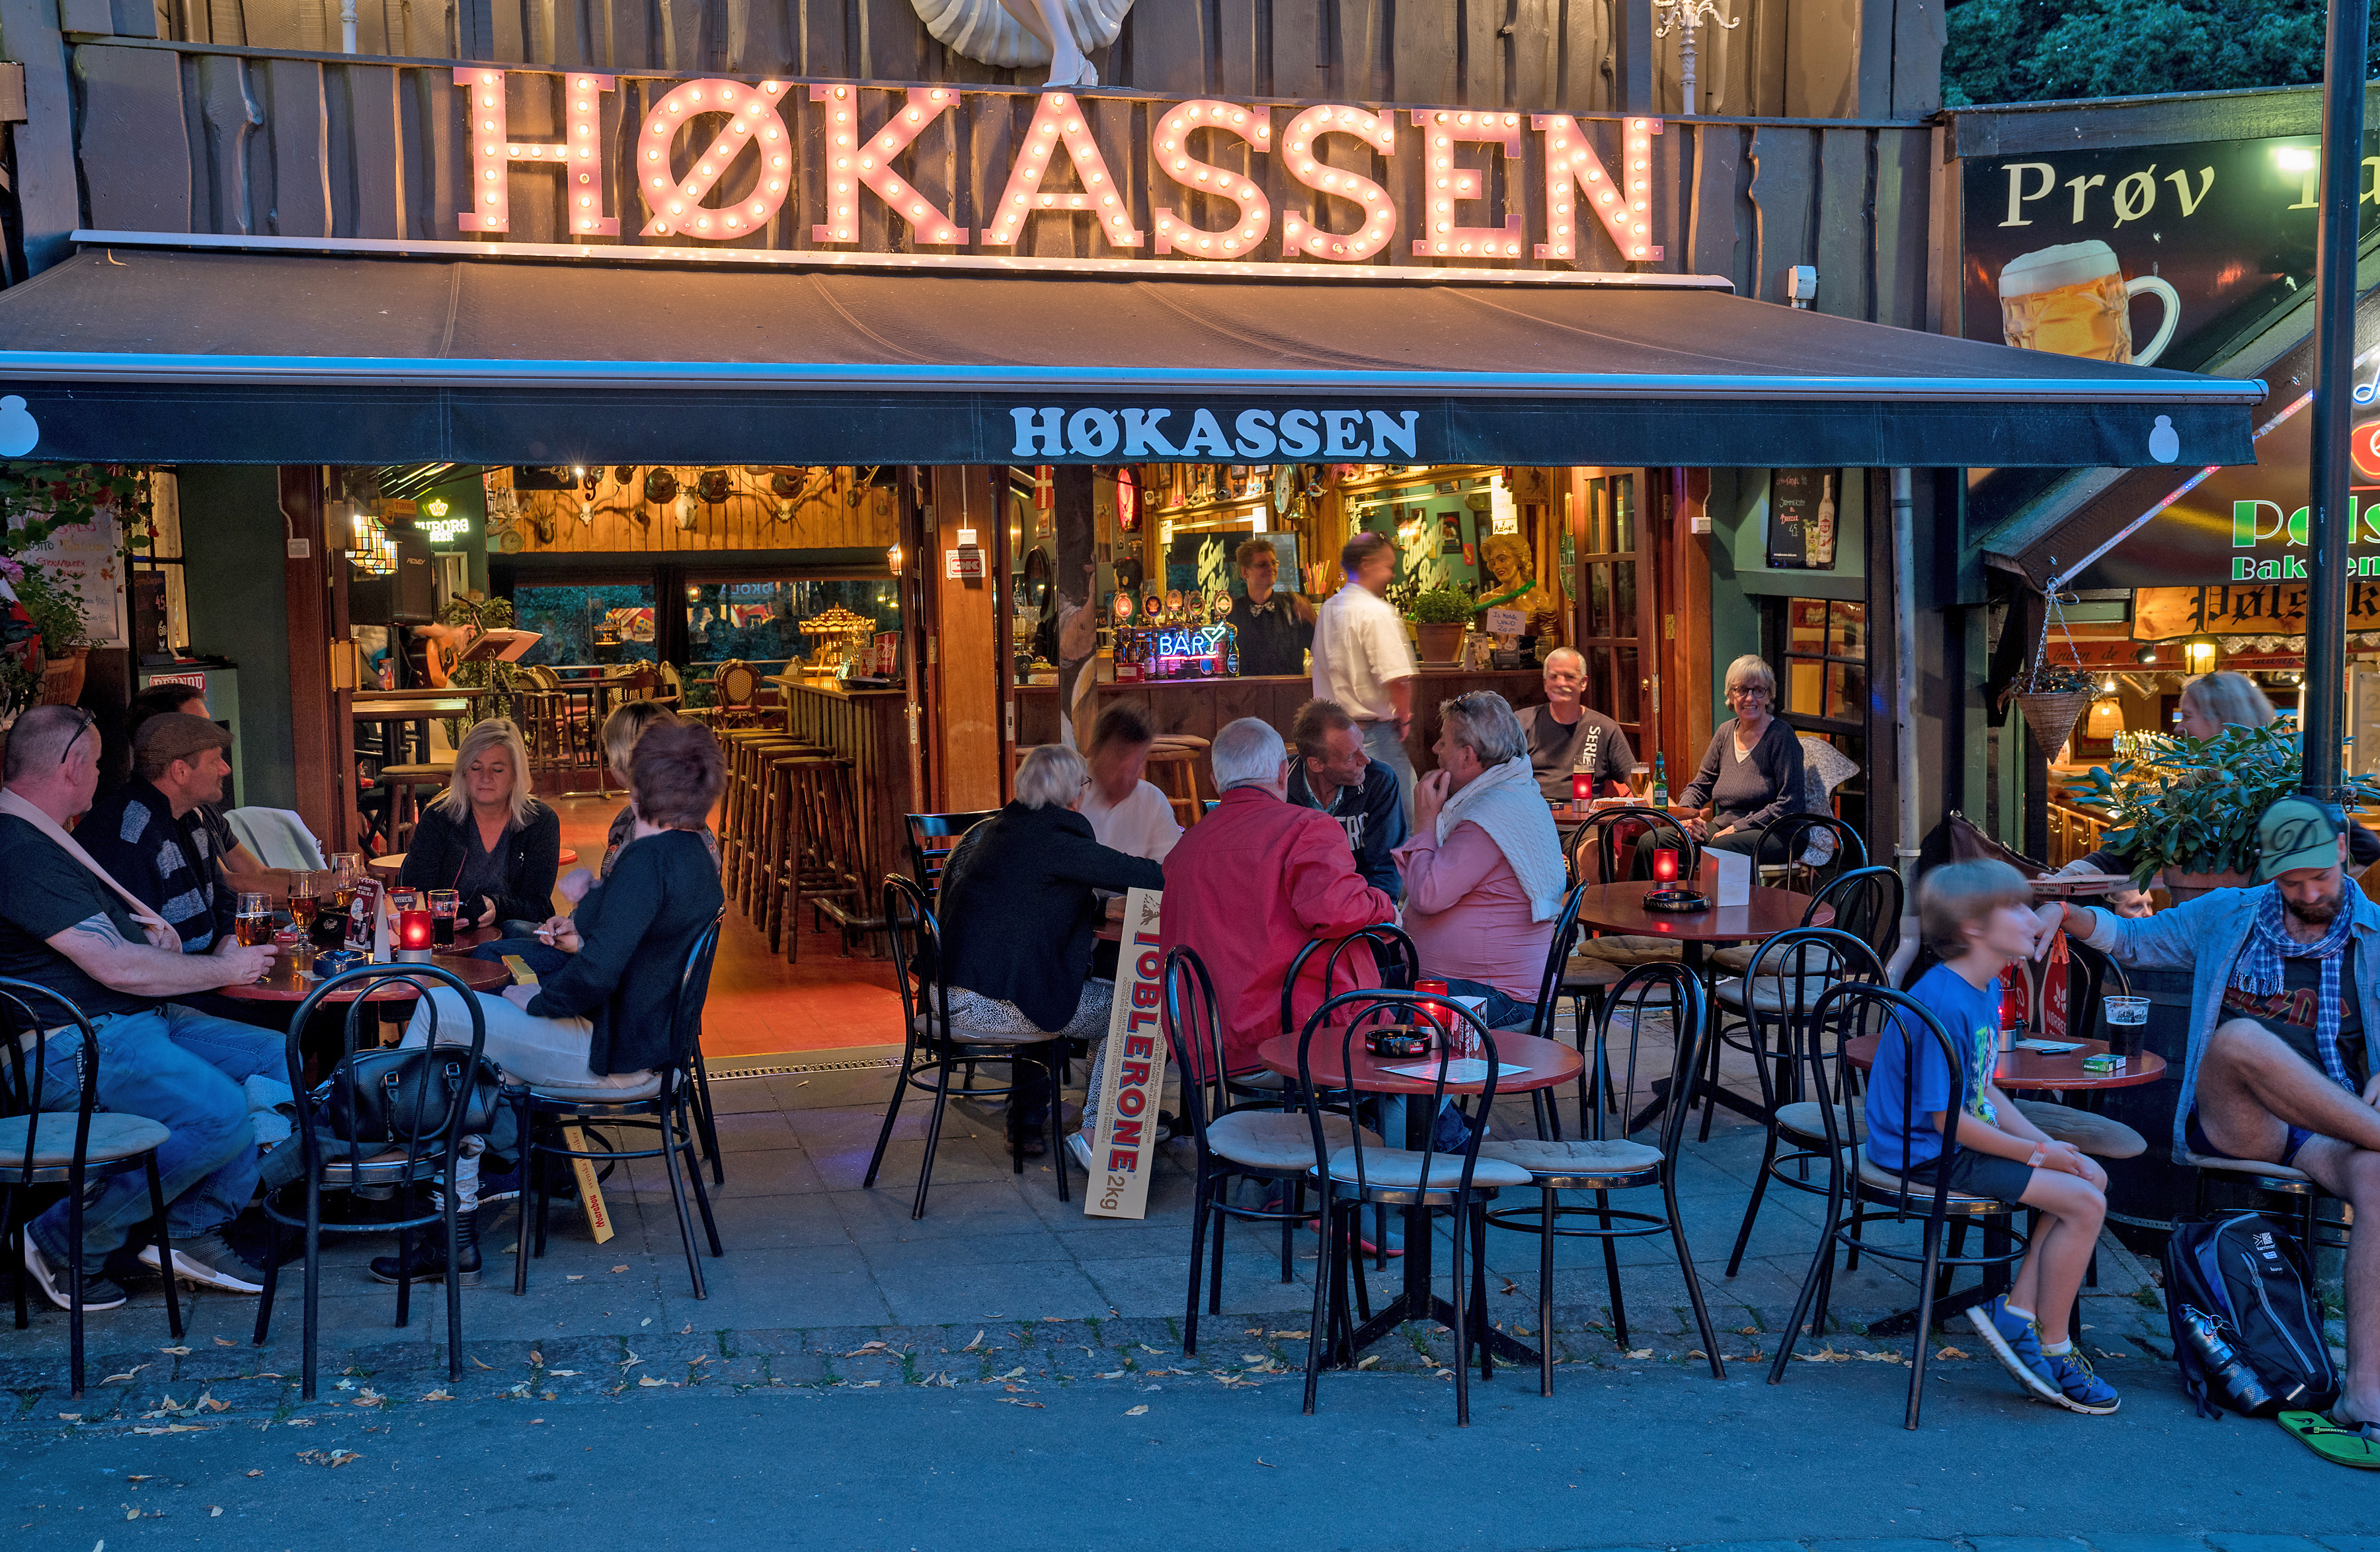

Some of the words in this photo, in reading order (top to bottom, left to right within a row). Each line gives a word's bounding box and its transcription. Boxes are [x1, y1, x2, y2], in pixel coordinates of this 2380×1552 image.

[453, 67, 1663, 261] HØKASSEN
[1997, 162, 2215, 228] Prøv
[1010, 407, 1419, 458] HØKASSEN
[395, 502, 415, 511] TUBORG
[26, 541, 54, 551] OJITO
[2232, 555, 2380, 581] Baken
[1107, 930, 1160, 1173] TOBLERONE
[1146, 1100, 1156, 1144] MANDEL-TORRONE
[582, 1163, 593, 1189] svenska
[590, 1194, 606, 1228] Marabou
[1099, 1174, 1125, 1210] 2kg
